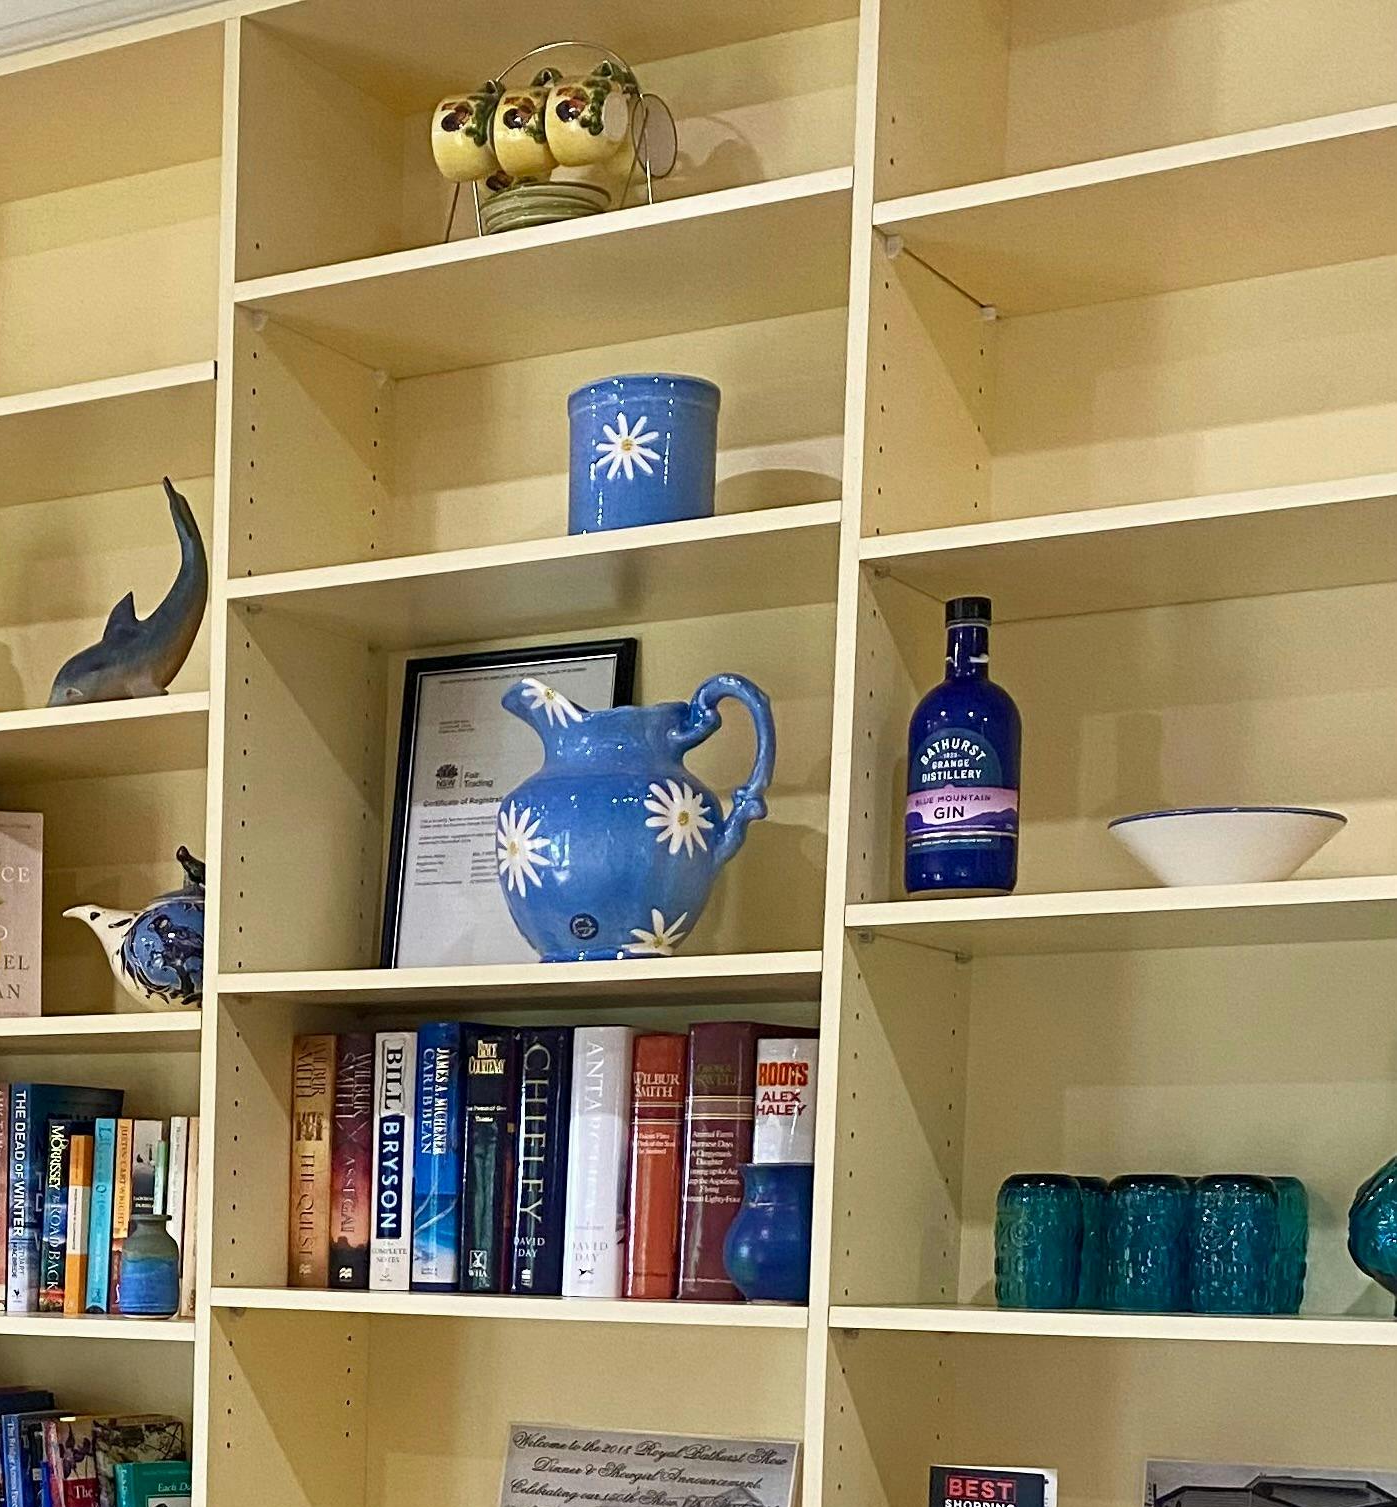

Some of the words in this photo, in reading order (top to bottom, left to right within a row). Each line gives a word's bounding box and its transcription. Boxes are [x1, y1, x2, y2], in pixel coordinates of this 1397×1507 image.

[920, 737, 987, 766] BATHURST
[931, 758, 970, 770] GRANGE
[464, 780, 494, 788] Trading
[921, 769, 982, 784] DISTILLERY
[914, 796, 934, 807] BLUE
[937, 793, 992, 804] MOUNTAIN
[933, 806, 966, 820] GIN
[295, 1043, 312, 1099] SMITH
[311, 1042, 327, 1097] WILBUR
[382, 1047, 403, 1110] BILL
[436, 1047, 451, 1086] JAMES
[634, 1071, 680, 1086] WILBUR
[758, 1061, 809, 1087] ROOTS
[335, 1052, 354, 1120] SMITH
[353, 1052, 372, 1123] WILBUR
[635, 1085, 673, 1098] SMITH
[760, 1090, 802, 1103] ALEX
[15, 1089, 26, 1119] THE
[421, 1047, 435, 1155] CARIBBEAN
[755, 1102, 807, 1116] HALEY
[14, 1120, 26, 1161] DEAD
[433, 1098, 448, 1155] MICHENER
[518, 1043, 551, 1222] CHIFLEY
[14, 1163, 25, 1179] OF
[49, 1124, 65, 1190] MORRISSEY
[299, 1153, 315, 1179] THE
[380, 1121, 400, 1230] BRYSON
[12, 1180, 26, 1237] WINTER
[340, 1157, 356, 1234] ASSEGAI
[49, 1201, 63, 1249] ROAD
[298, 1192, 315, 1256] QUEST
[514, 1236, 546, 1247] DAVID
[518, 1248, 538, 1258] DAY
[18, 1242, 26, 1275] STUART
[46, 1250, 61, 1290] BACK
[575, 1252, 598, 1262] DAY
[7, 1422, 15, 1437] The
[512, 1430, 567, 1450] Welcome
[568, 1440, 582, 1451] to
[582, 1439, 602, 1453] the
[602, 1443, 633, 1455] 2018
[634, 1440, 684, 1463] Royal
[683, 1443, 747, 1464] Bathurst
[747, 1447, 788, 1466] Show
[531, 1456, 584, 1475] Dinner
[584, 1463, 597, 1476] &
[597, 1461, 663, 1485] Showgirl
[73, 1484, 94, 1500] The
[157, 1482, 178, 1493] Each
[510, 1478, 580, 1504] Celebrating
[639, 1489, 678, 1506] Show
[947, 1478, 1014, 1500] BEST
